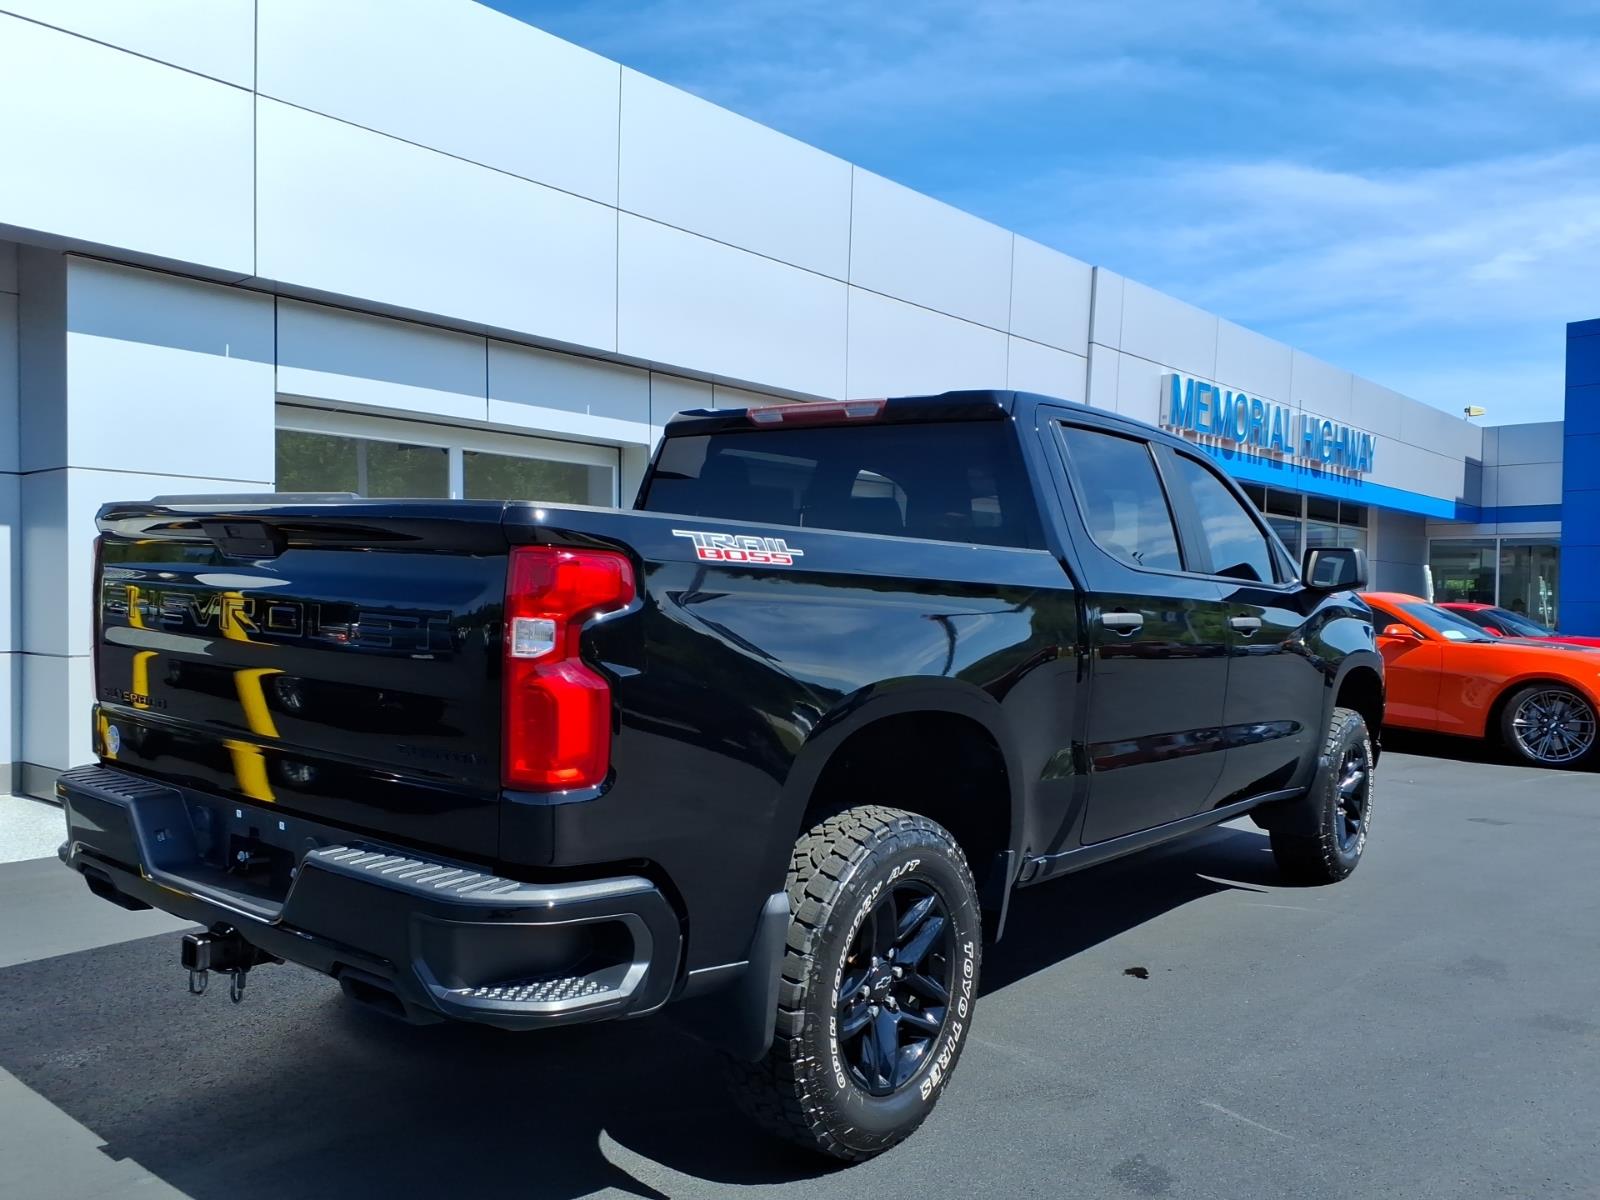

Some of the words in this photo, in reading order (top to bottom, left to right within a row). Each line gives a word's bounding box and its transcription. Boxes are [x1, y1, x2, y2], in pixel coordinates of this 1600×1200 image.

[1161, 373, 1294, 454] MEMORIAL
[1297, 414, 1376, 474] HIGHWAY
[672, 529, 804, 556] TRAIL
[697, 547, 793, 565] BOSS
[104, 585, 451, 652] CHEVROLET
[886, 859, 921, 885] A/T
[958, 941, 974, 1018] TOYO
[919, 1021, 963, 1101] TIRES
